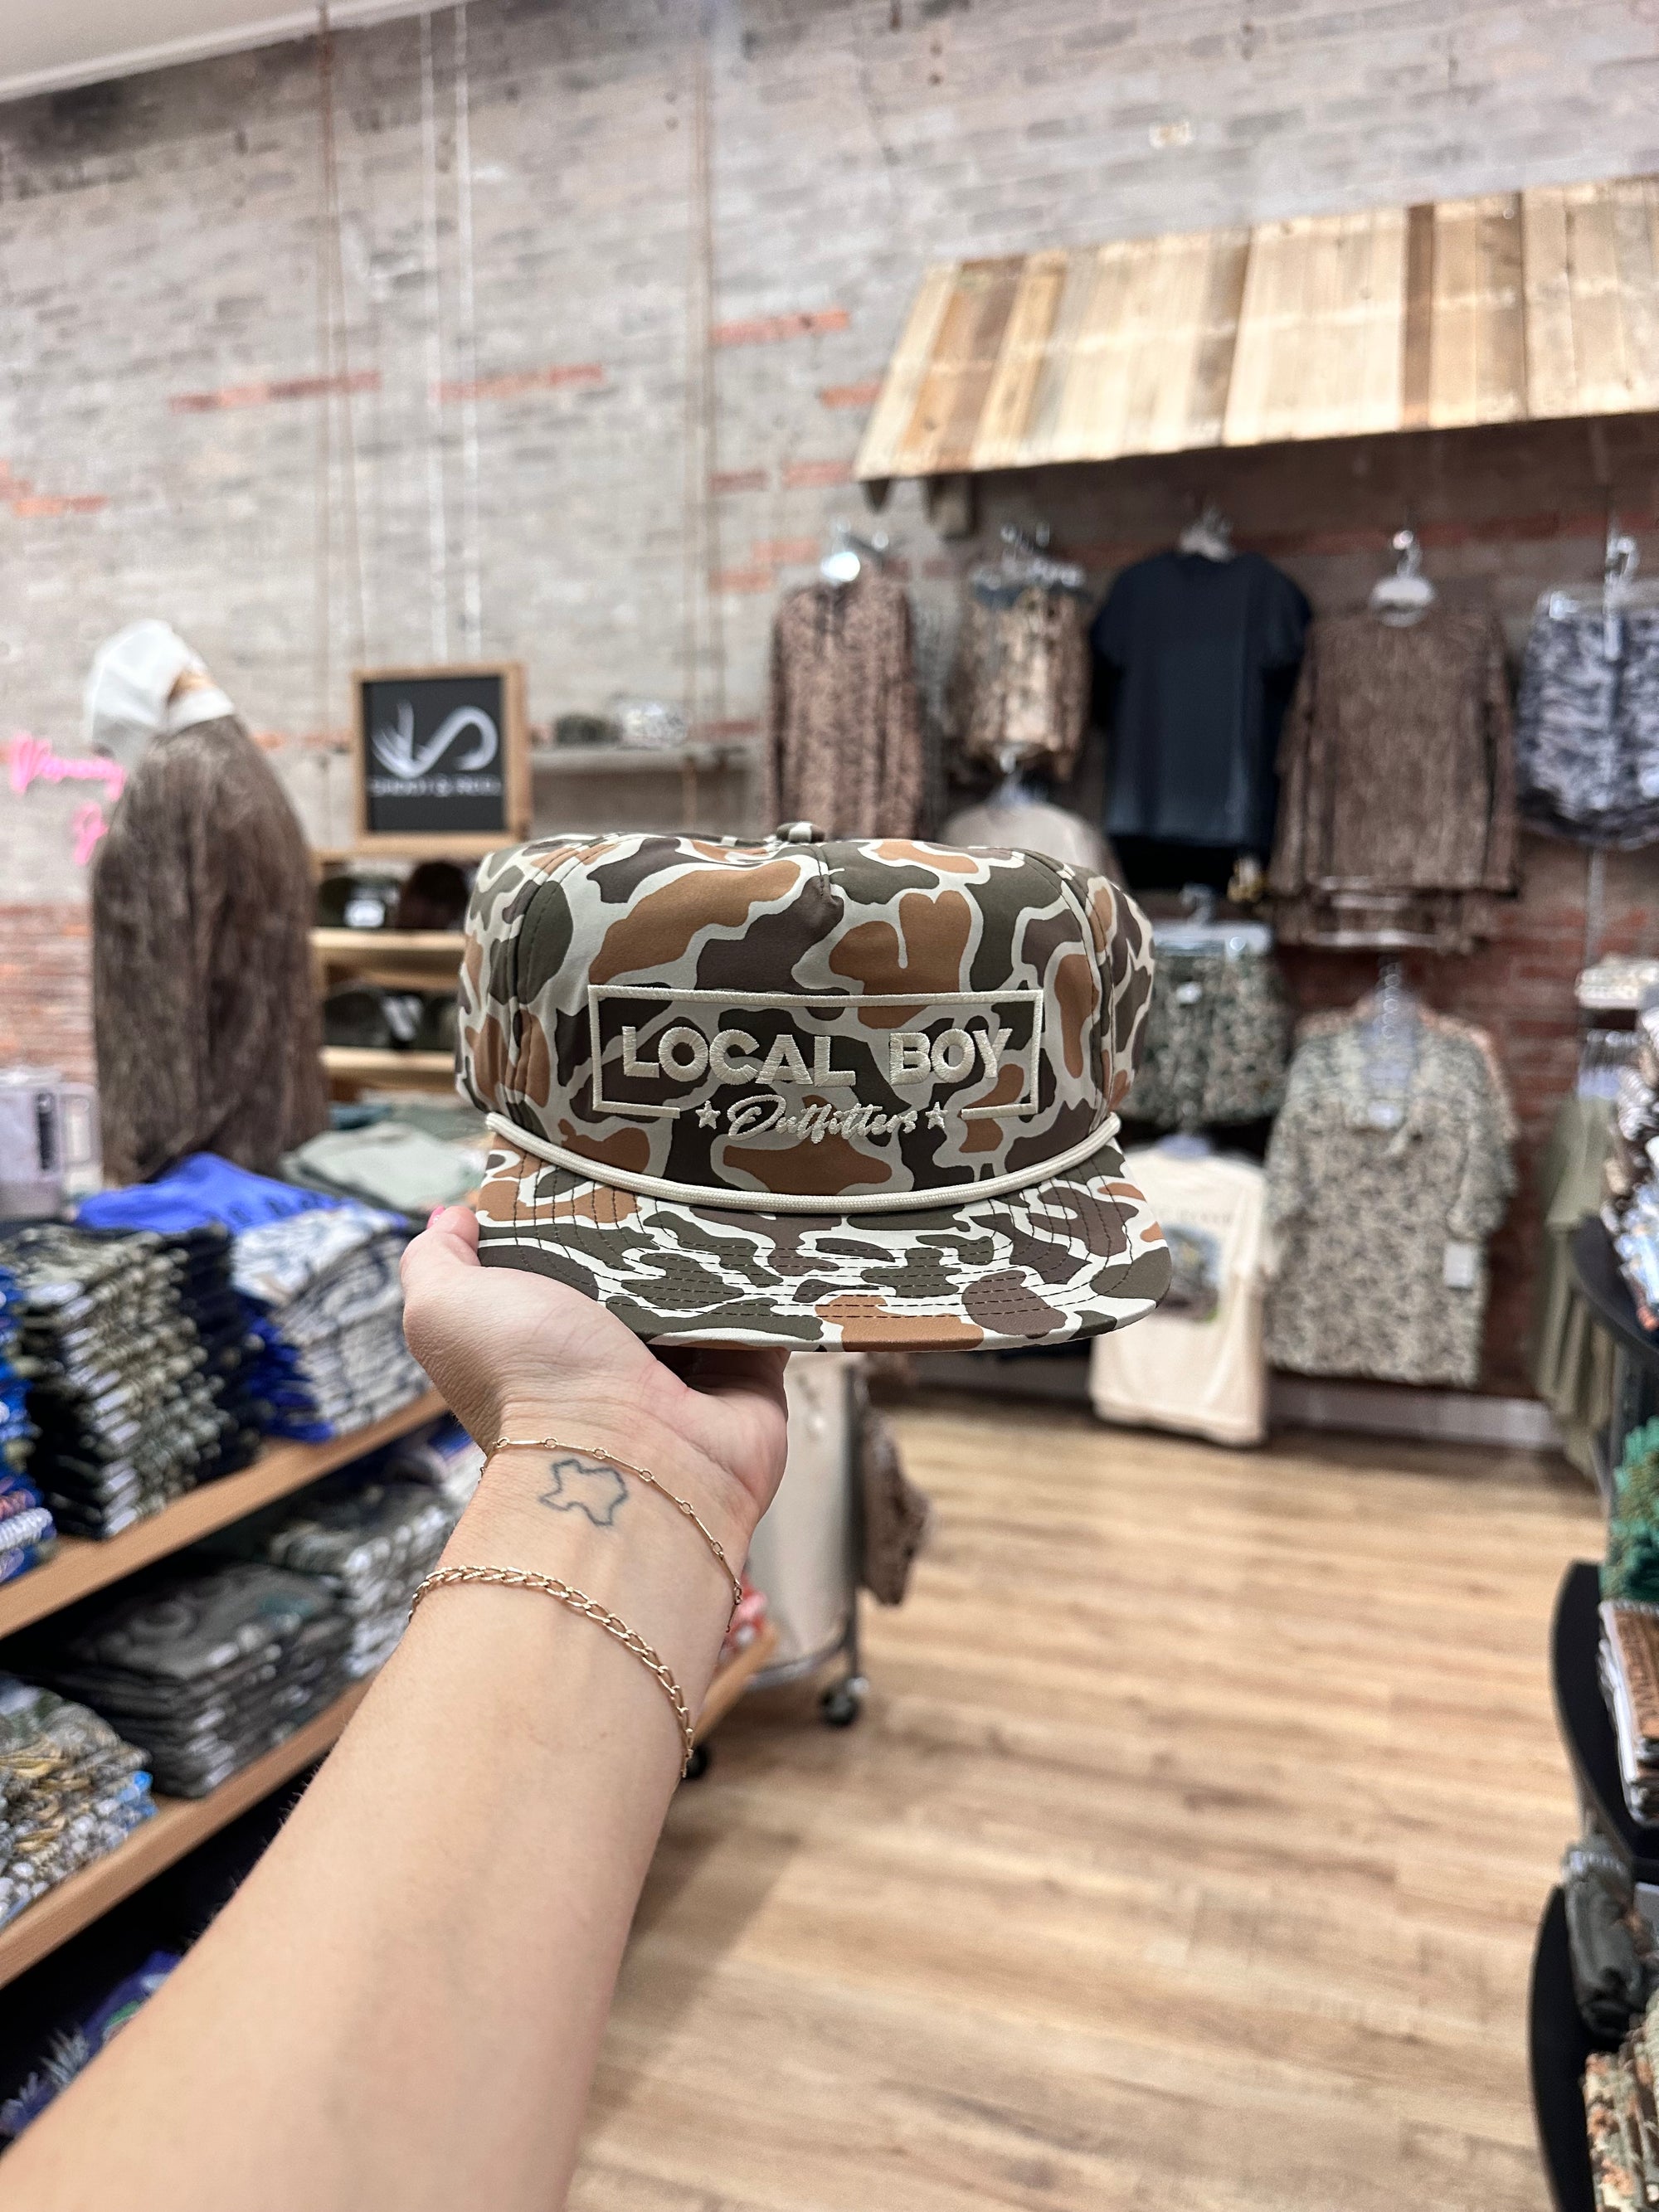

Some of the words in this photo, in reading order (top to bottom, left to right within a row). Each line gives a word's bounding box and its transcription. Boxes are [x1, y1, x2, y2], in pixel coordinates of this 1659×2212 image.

[622, 1026, 856, 1087] LOCAL
[889, 1028, 1014, 1085] BOY
[727, 1094, 918, 1144] Outfitters
